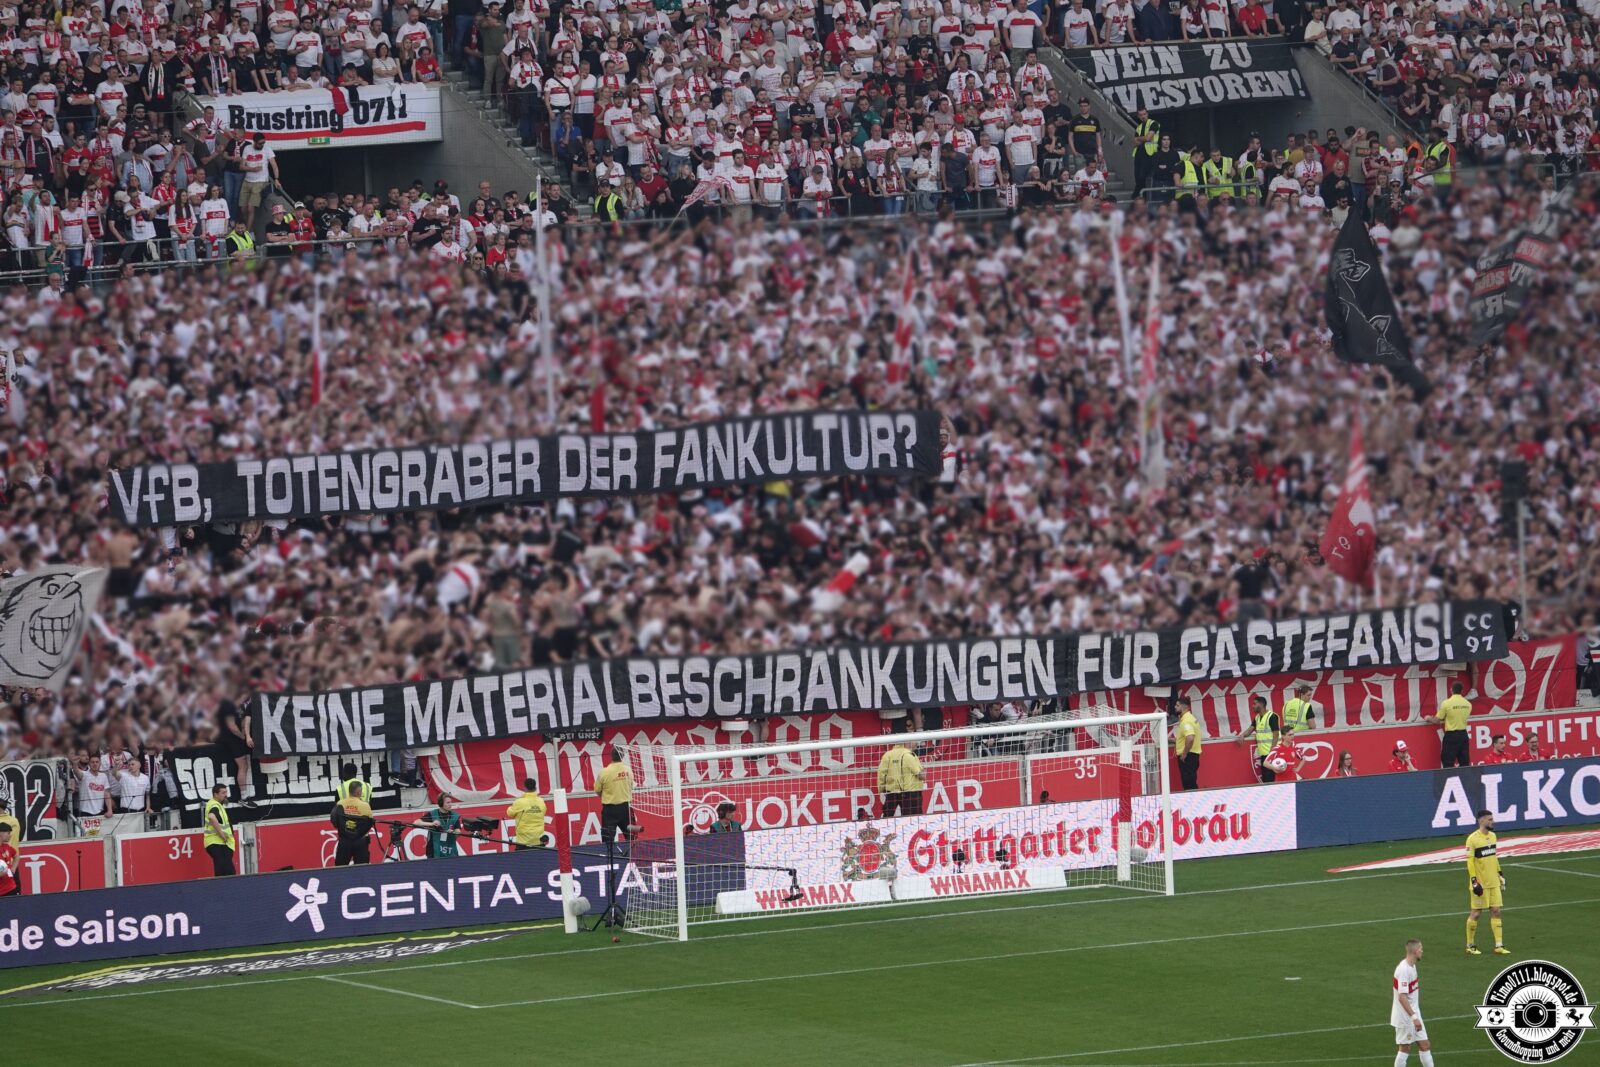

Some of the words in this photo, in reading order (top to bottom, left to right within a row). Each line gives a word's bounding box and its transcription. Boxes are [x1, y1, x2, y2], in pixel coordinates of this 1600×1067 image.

[1091, 45, 1184, 83] NEIN
[1202, 42, 1253, 71] ZU
[1102, 68, 1306, 113] VESTOREN!
[228, 104, 343, 133] Brustring
[351, 93, 407, 124] 0711
[111, 465, 212, 523] VfB,
[237, 438, 541, 517] TOTENGRÄBER
[558, 434, 637, 492] DER
[653, 413, 918, 489] FANKULTUR?
[1464, 613, 1494, 632] CC
[1466, 634, 1495, 654] 97
[260, 688, 387, 755] KEINE
[402, 638, 1058, 746] MATERIALBESCHRÄNKUNGEN
[1077, 631, 1160, 692] FÜR
[1180, 602, 1453, 681] GÄSTEFANS!
[1484, 640, 1563, 715] 97
[1074, 756, 1098, 780] 35
[168, 837, 193, 861] 34
[907, 821, 1101, 874] Stuttgarter
[755, 883, 856, 910] WINAMAX
[930, 868, 1032, 896] WINAMAX
[54, 909, 201, 949] Saison.
